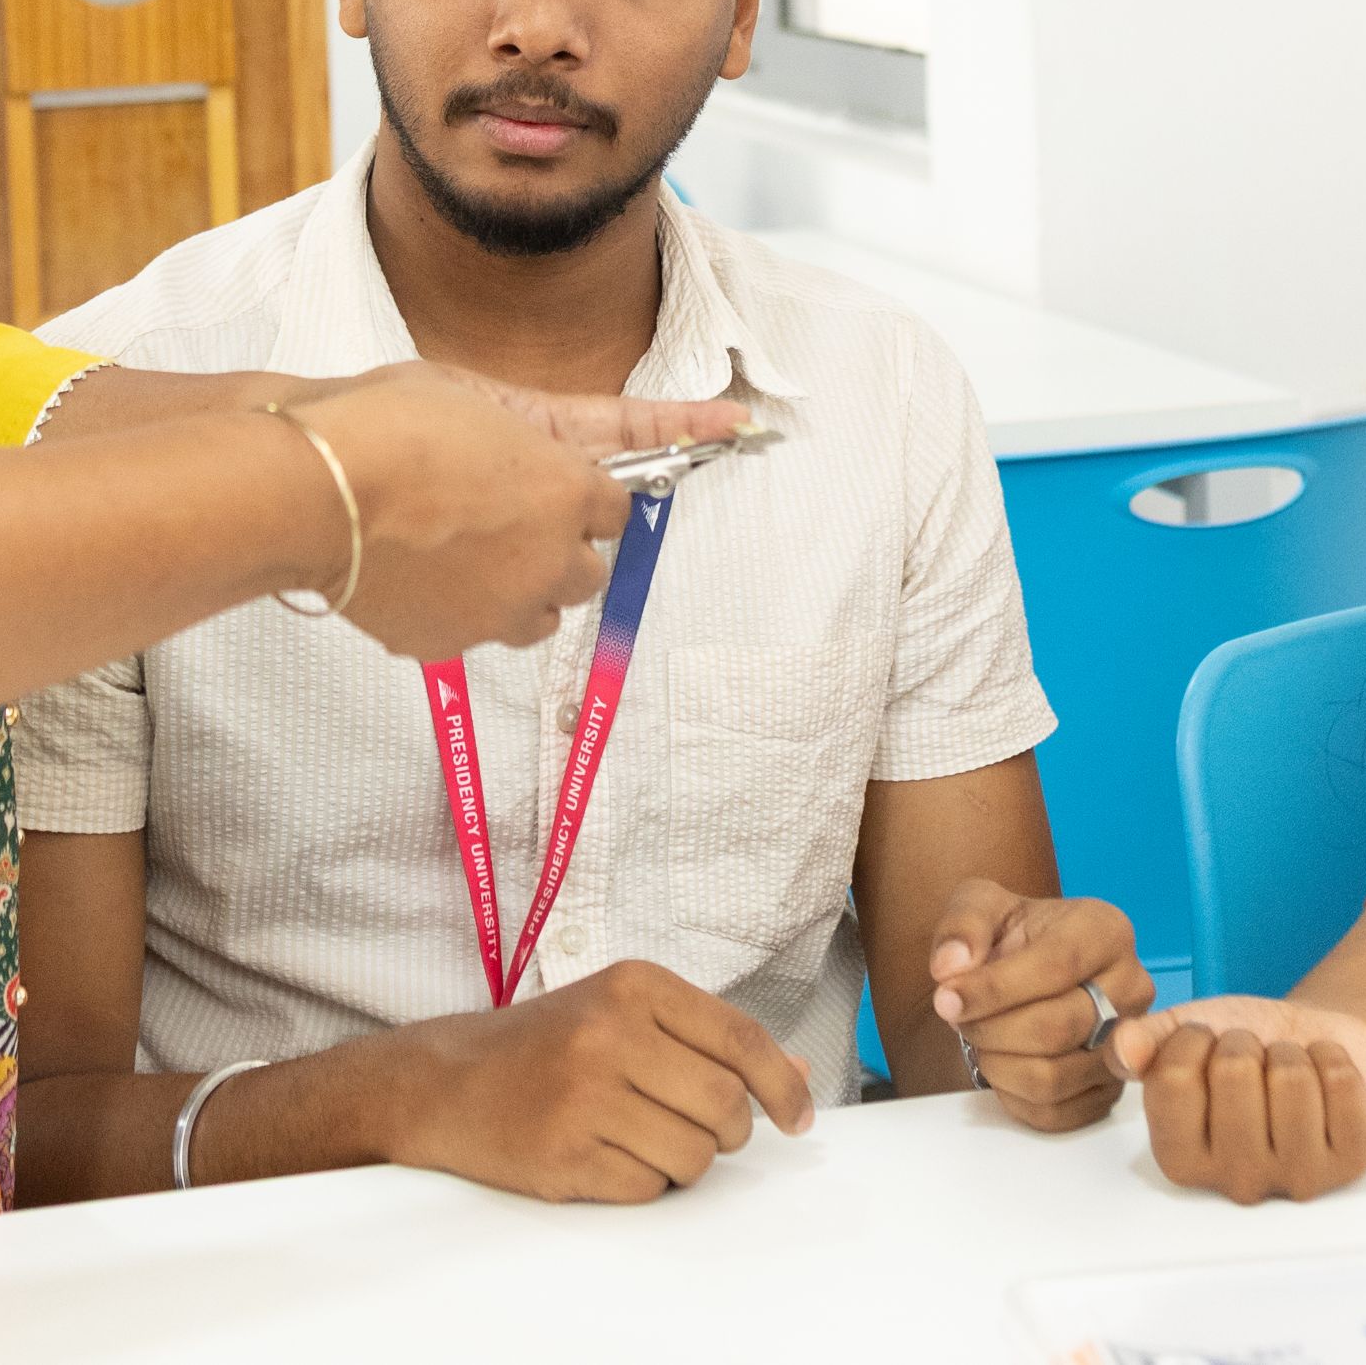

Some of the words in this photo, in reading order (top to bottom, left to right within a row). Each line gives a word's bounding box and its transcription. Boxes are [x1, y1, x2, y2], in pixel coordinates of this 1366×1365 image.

[446, 713, 481, 837] PRESIDENCY
[470, 842, 499, 963] UNIVERSITY
[527, 814, 574, 936] PRESIDENCY
[564, 695, 608, 812] UNIVERSITY
